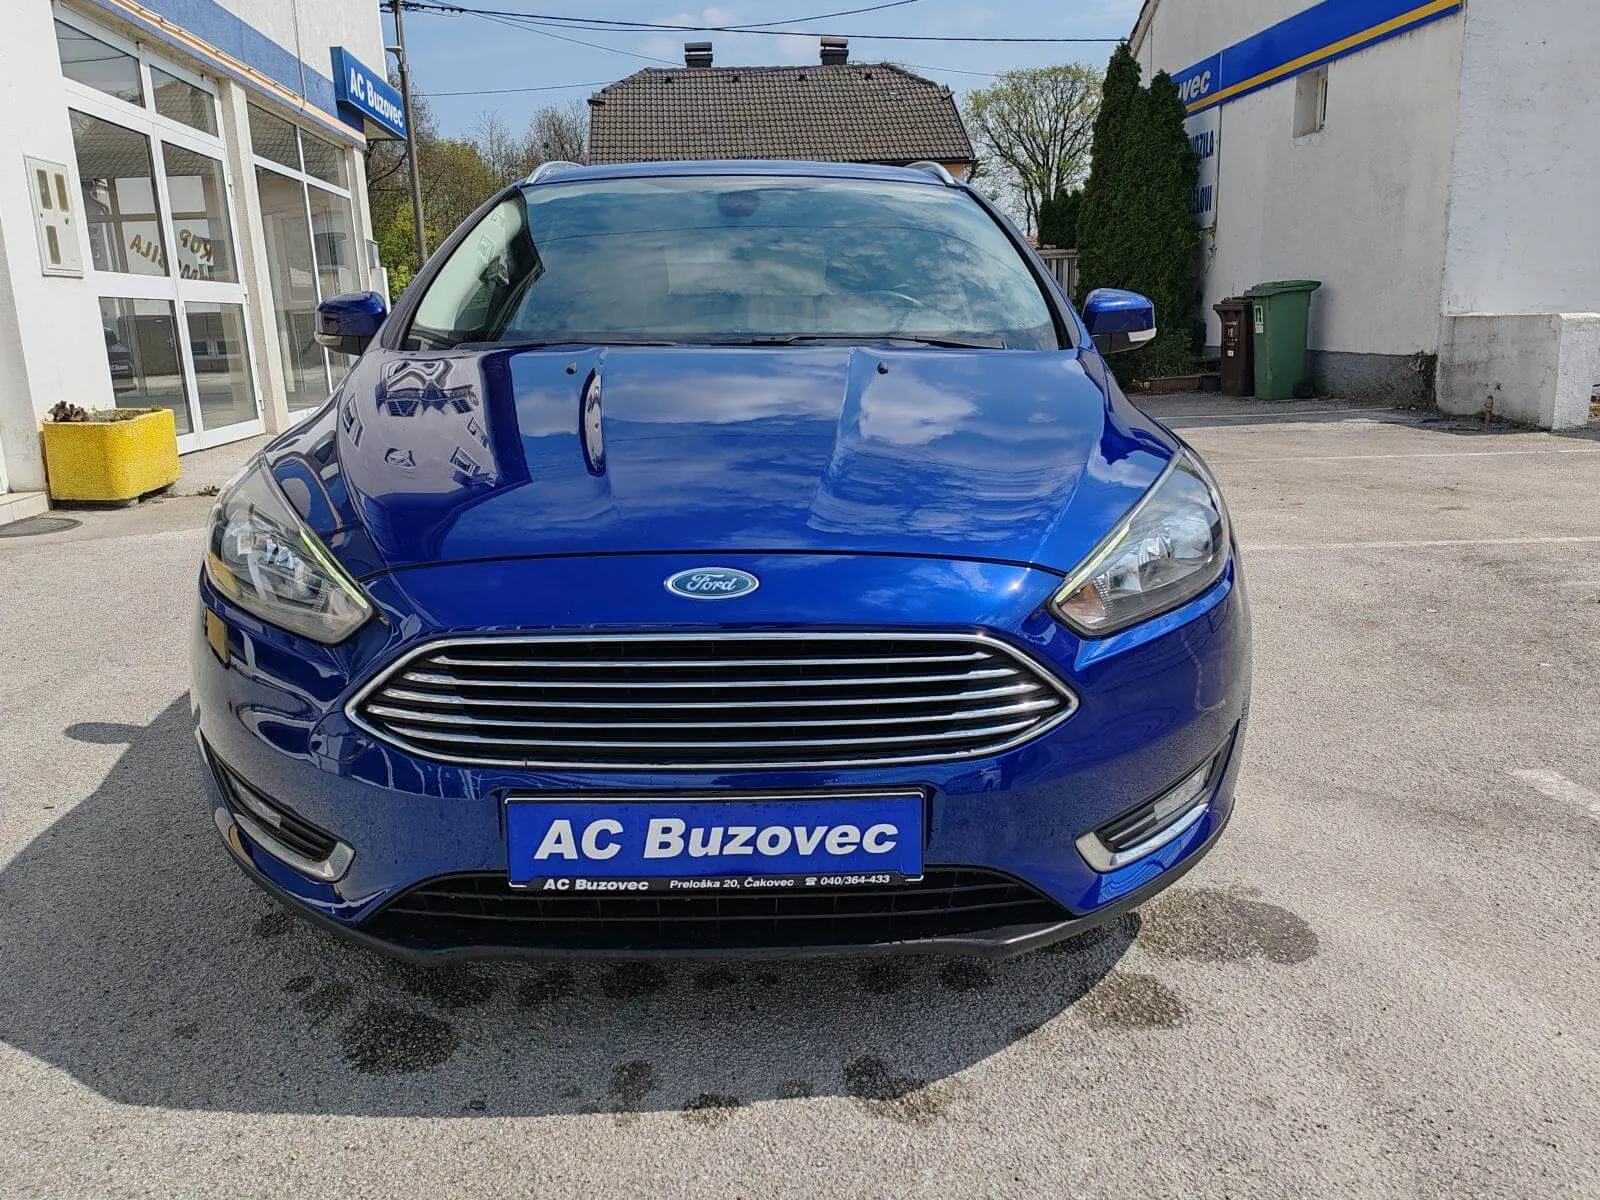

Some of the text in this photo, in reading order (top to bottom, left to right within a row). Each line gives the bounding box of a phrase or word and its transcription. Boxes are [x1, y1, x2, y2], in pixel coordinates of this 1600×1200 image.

[350, 67, 403, 128] AC Buzovec
[686, 573, 738, 591] Ford
[533, 817, 899, 860] AC Buzovec
[543, 874, 890, 891] AC Buzovec Preloška 20, Čakovec 040/364-433
